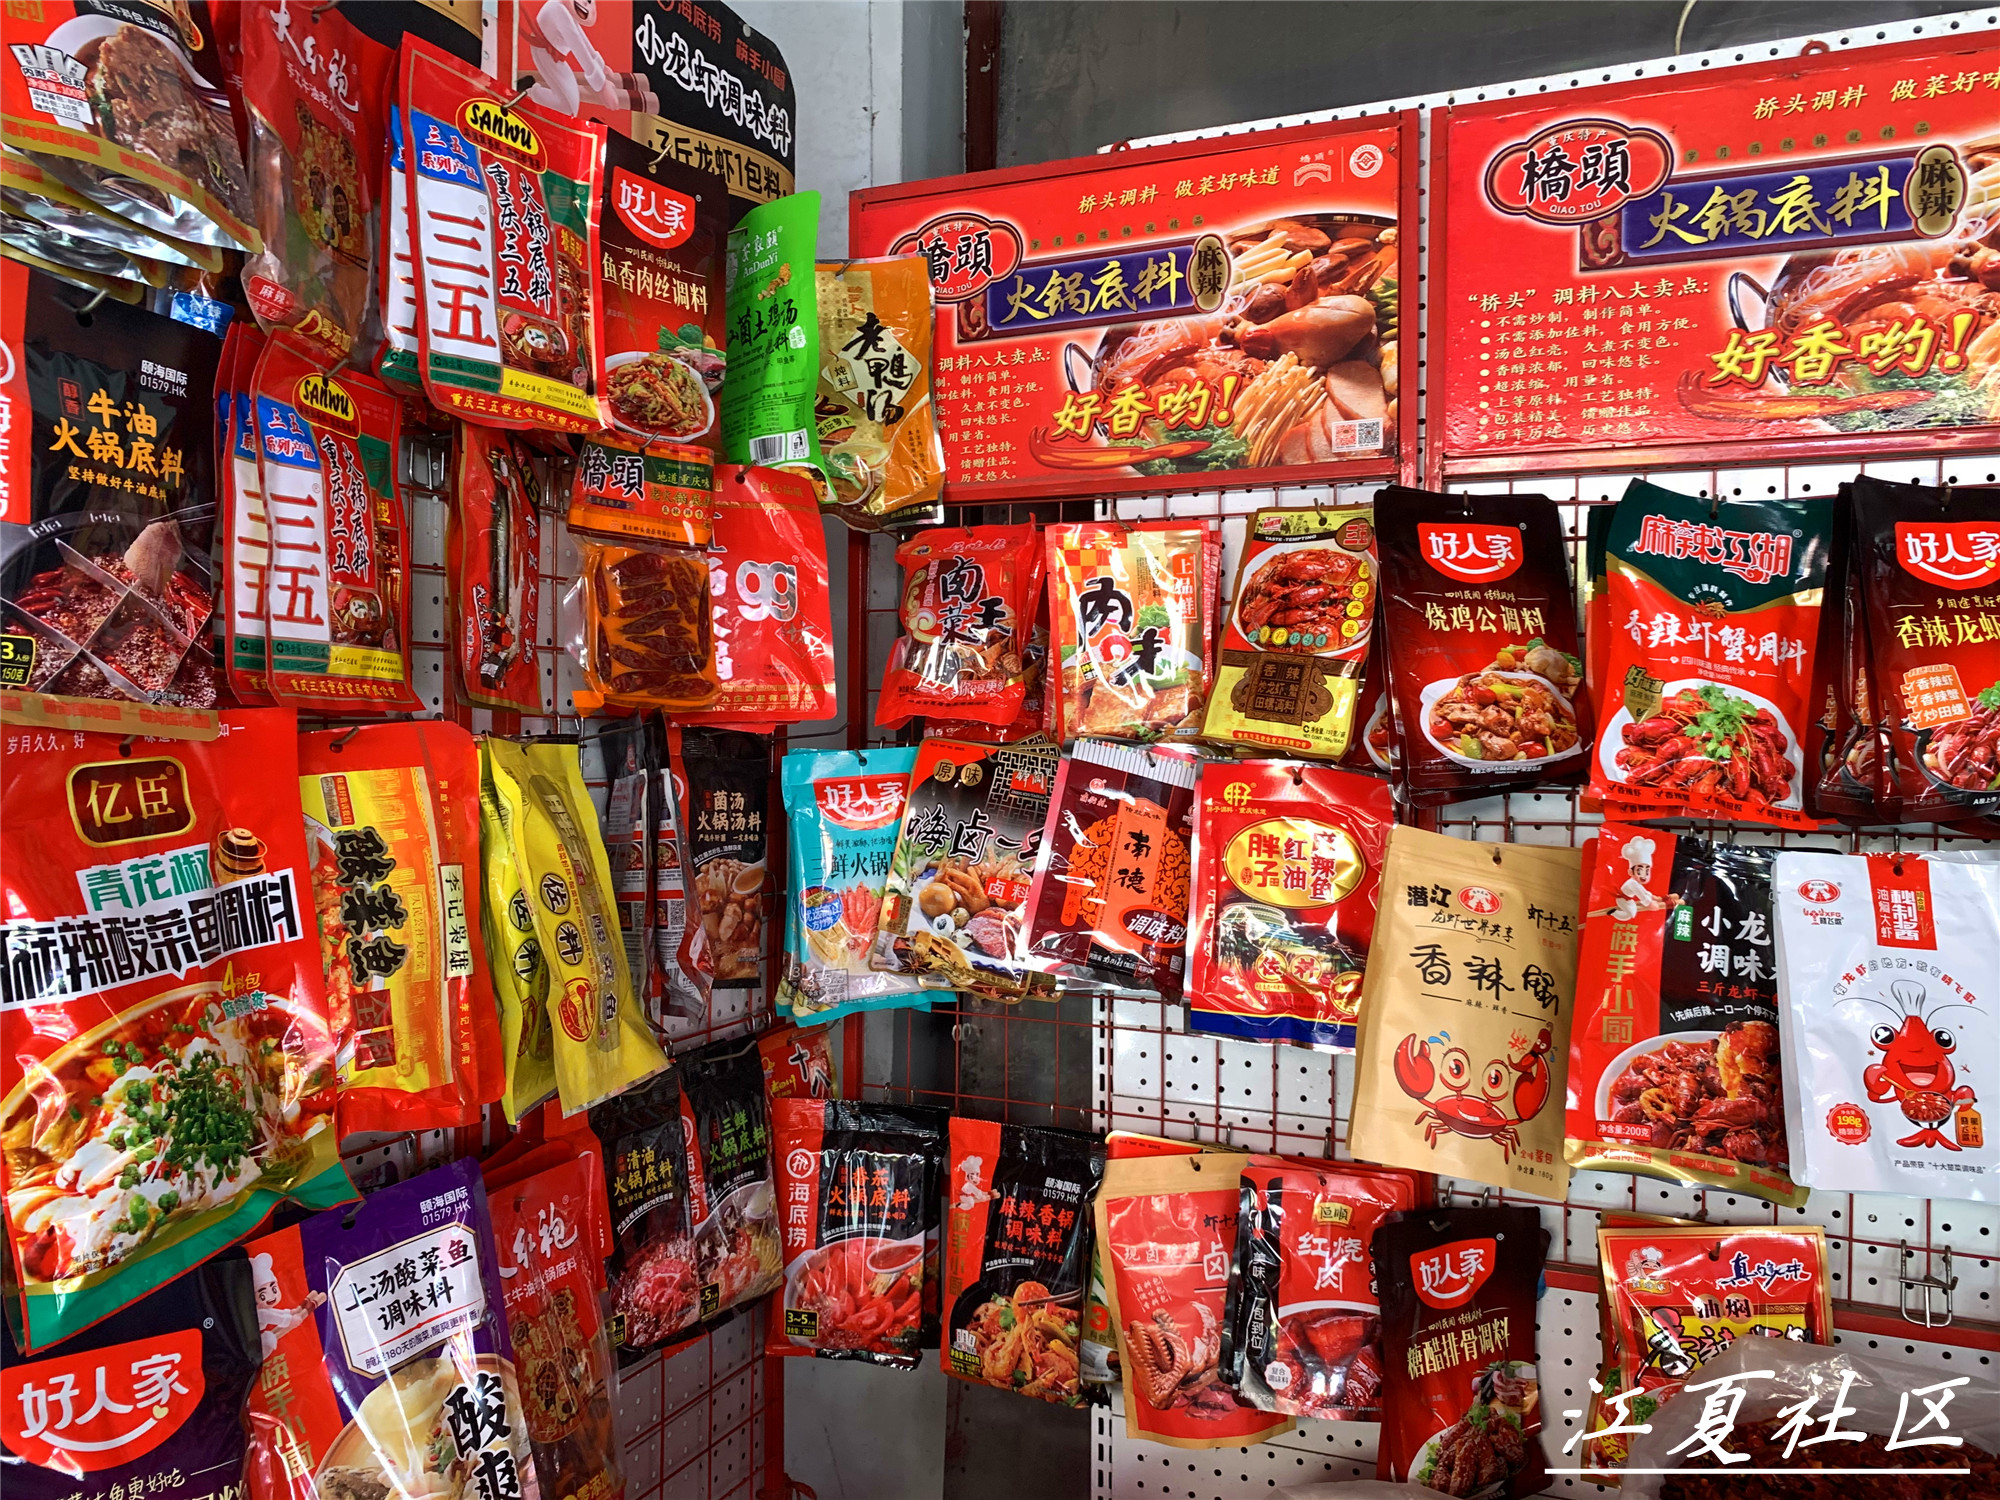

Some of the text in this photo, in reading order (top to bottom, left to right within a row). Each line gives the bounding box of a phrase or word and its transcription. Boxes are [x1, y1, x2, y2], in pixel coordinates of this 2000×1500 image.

[677, 0, 786, 91] 海底捞 筷手小厨
[635, 13, 792, 157] 小龙虾调味料
[1753, 85, 1868, 121] 桥头调料
[424, 124, 468, 158] 三五
[468, 103, 533, 151] SANWU
[1546, 128, 1608, 148] 重庆特产
[420, 150, 481, 184] 系列产品
[1520, 138, 1631, 206] 橋頭
[1077, 165, 1281, 215] 桥头调料 做菜好味道
[1918, 158, 1956, 220] 麻辣
[618, 179, 687, 232] 好人家
[1549, 199, 1602, 215] QIAO TOU
[1639, 165, 1901, 250] 火锅底料
[486, 162, 525, 299] 重庆三五
[519, 174, 553, 313] 火锅底料
[930, 221, 976, 237] 重庆特产
[601, 252, 709, 316] 鱼香肉丝调料
[1196, 244, 1223, 297] 麻辣
[260, 282, 289, 309] 麻辣
[935, 281, 974, 296] QIAO TOU
[999, 251, 1187, 324] 火锅底料
[1552, 276, 1711, 307] 调料八大卖点:
[1495, 303, 1662, 328] 不需炒制, 制作简单。
[1495, 317, 1700, 345] 不需添加佐料, 食用方便。
[937, 346, 1051, 373] 调料八大卖点:
[1494, 336, 1680, 361] 汤色红亮, 久煮不变色。
[1706, 313, 1975, 384] 好香哟!
[140, 359, 188, 387] 颐海国际
[842, 311, 914, 427] 老鸭汤
[960, 370, 1018, 385] 制作简单。
[1495, 353, 1661, 377] 香醇浓郁, 回味悠长。
[140, 374, 188, 398] 01579.HK
[301, 378, 351, 418] SANWU
[986, 382, 1045, 397] 食用方便。
[1493, 373, 1625, 394] 超浓缩, 用量省。
[1494, 386, 1661, 410] 上等原料, 工艺独特。
[87, 387, 158, 438] 牛油
[267, 407, 305, 437] 三五
[960, 400, 1032, 414] 久煮不变色。
[960, 414, 1018, 428] 回味悠长。
[1050, 375, 1241, 440] 好香哟!
[1580, 420, 1663, 437] 历史悠久。
[48, 416, 186, 489] 火锅底料
[263, 433, 317, 463] 系列产品
[960, 442, 1018, 456] 工艺独特。
[67, 464, 168, 502] 坚持做好牛油底料
[580, 444, 646, 502] 橋頭
[656, 469, 711, 489] 地道重庆味
[960, 470, 1018, 484] 历史悠久。
[320, 433, 351, 572] 重庆三五
[341, 442, 370, 583] 火锅底料
[1428, 531, 1516, 562] 好人家
[1635, 514, 1794, 580] 麻辣江湖
[1904, 531, 2000, 565] 好人家
[1425, 601, 1547, 636] 烧鸡公调料
[1623, 608, 1808, 676] 香辣虾蟹调料
[1262, 663, 1301, 680] 香辣
[1915, 675, 1954, 691] 香辣虾
[1254, 696, 1296, 714] 田螺调料
[1919, 689, 1961, 707] 香辣蟹
[1922, 703, 1967, 723] 炒田螺
[936, 760, 982, 785] 原味
[85, 773, 176, 828] 亿臣
[713, 789, 745, 811] 菌汤
[823, 781, 907, 812] 好人家
[696, 810, 762, 832] 火锅汤料
[1113, 829, 1152, 895] 南德
[1247, 832, 1282, 889] 胖子
[1283, 837, 1310, 892] 红油
[85, 848, 215, 912] 青花椒
[986, 879, 1031, 902] 卤料
[1406, 884, 1453, 908] 潜江
[1126, 912, 1187, 946] 调味料
[1431, 911, 1516, 943] 龙虾世界共享
[1526, 903, 1574, 933] 虾十五
[1676, 909, 1692, 938] 麻辣
[1701, 905, 1772, 946] 小龙
[1876, 888, 1894, 939] 油焖大虾
[1890, 889, 1919, 941] 秘制酱
[1408, 943, 1561, 1018] 香辣蟹
[1602, 921, 1639, 1044] 筷手小厨
[721, 1110, 750, 1138] 三鲜
[1598, 1123, 1650, 1138] 净含量:200克
[1836, 1115, 1863, 1128] 198g
[626, 1145, 655, 1171] 清油
[708, 1123, 768, 1167] 火锅底料
[613, 1157, 673, 1197] 火锅底料
[852, 1165, 890, 1187] 番茄
[1894, 1159, 1926, 1170] 产品荣获
[419, 1186, 469, 1215] 颐海国际
[828, 1184, 911, 1210] 火锅底料
[1042, 1187, 1080, 1204] 01579.HK
[1044, 1176, 1081, 1194] 颐海国际
[421, 1200, 472, 1226] 01579.HK
[786, 1182, 812, 1249] 海底捞
[998, 1194, 1075, 1231] 麻辣香锅
[1005, 1219, 1063, 1251] 调味料
[1296, 1231, 1365, 1263] 红烧
[345, 1238, 475, 1313] 上汤酸菜鱼
[1203, 1240, 1230, 1283] 卤
[1252, 1251, 1267, 1278] 美味
[1313, 1258, 1344, 1294] 肉
[1418, 1248, 1486, 1293] 好人家
[377, 1275, 455, 1332] 调味料
[1089, 1308, 1110, 1332] 3
[1406, 1316, 1511, 1381] 糖醋排骨调料
[1271, 1366, 1287, 1375] 复合
[17, 1352, 190, 1439] 好人家
[444, 1371, 521, 1500] 酸爽
